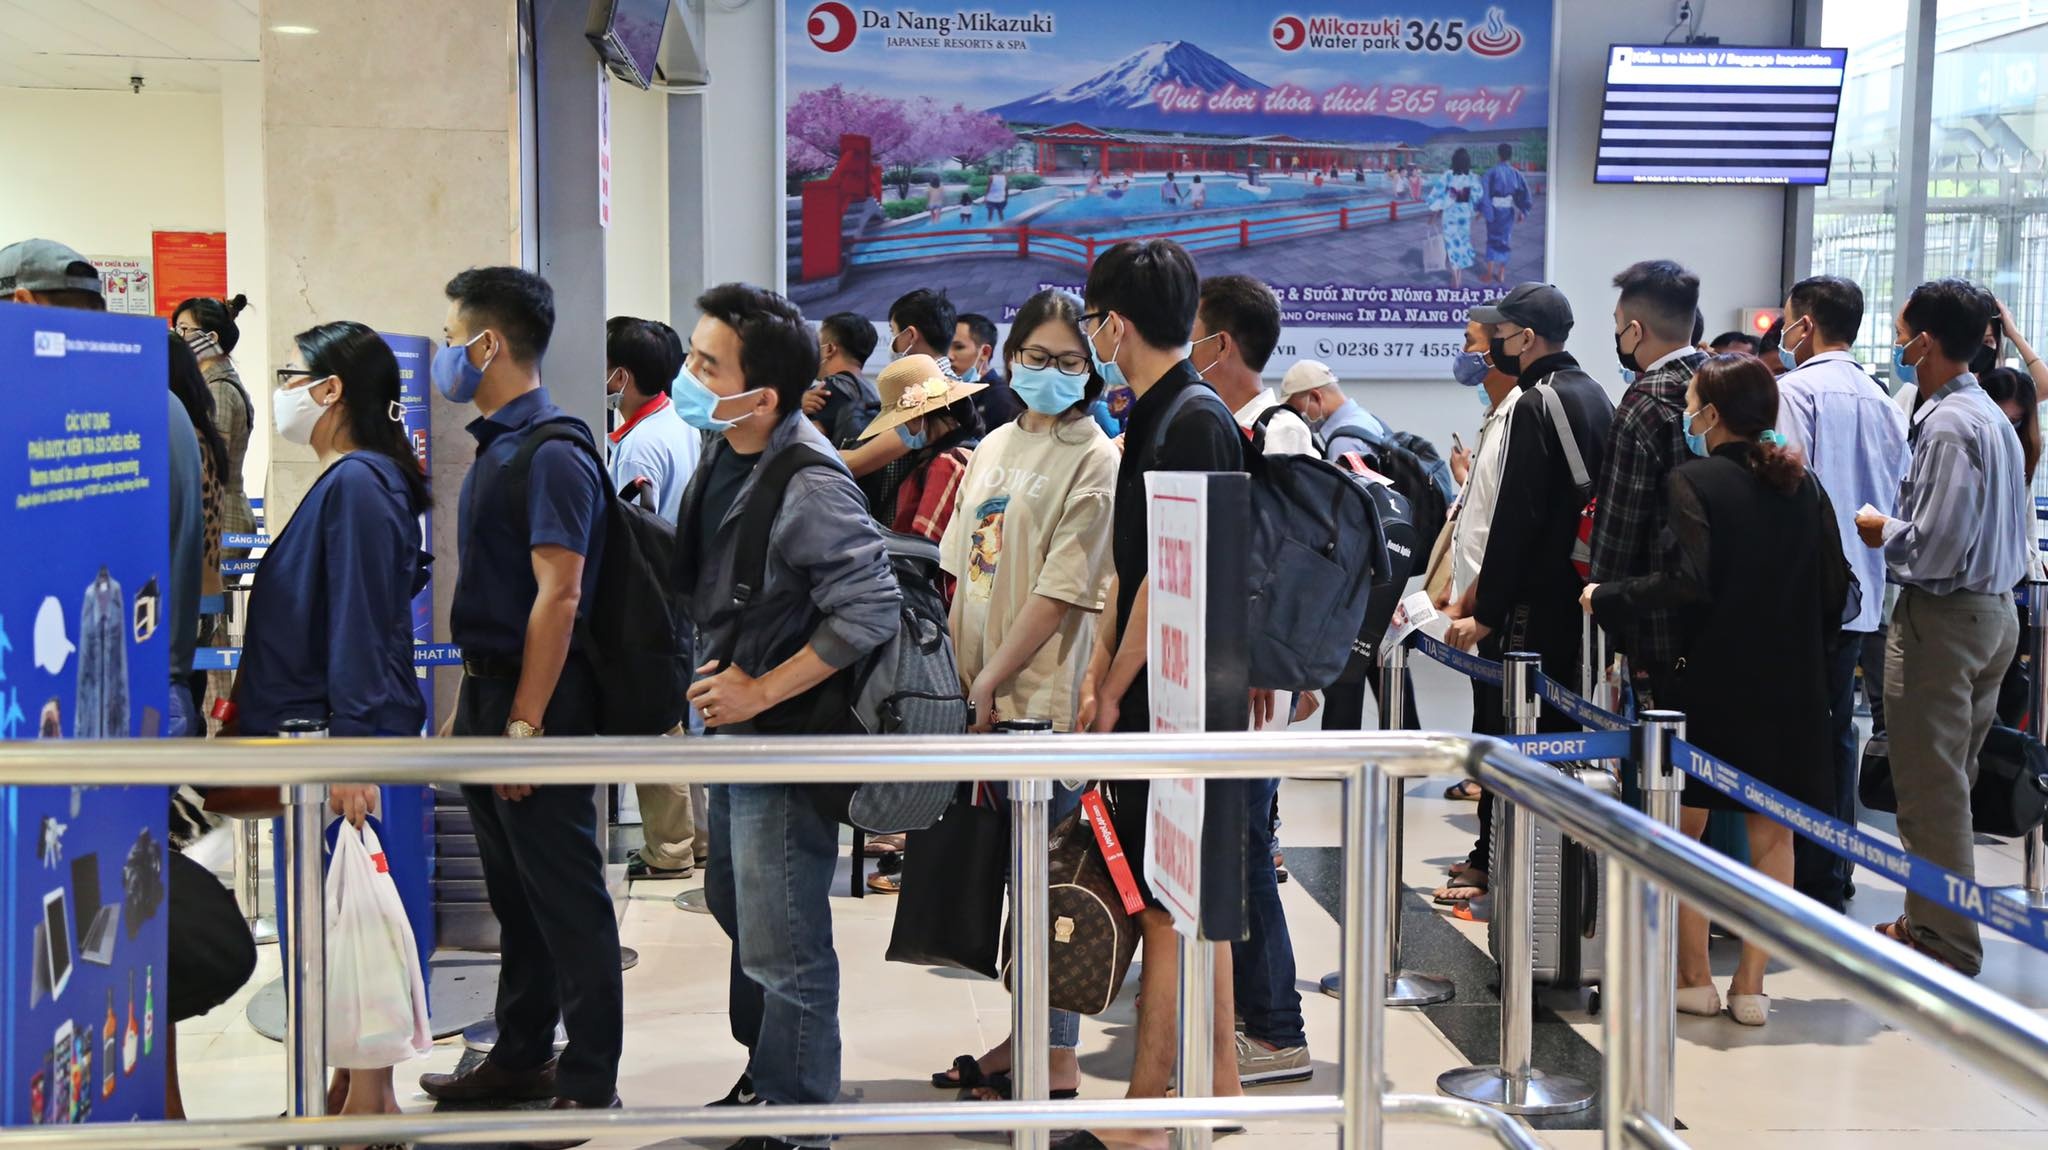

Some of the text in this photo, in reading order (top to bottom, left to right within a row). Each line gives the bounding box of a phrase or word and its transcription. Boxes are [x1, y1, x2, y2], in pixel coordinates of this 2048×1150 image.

[862, 10, 890, 29] Da
[1308, 18, 1400, 36] Mikazuki
[886, 36, 1028, 50] JAPANESE RESORTS & SPA
[1309, 35, 1401, 52] Water park
[1404, 20, 1464, 52] 365
[1156, 84, 1200, 111] Vui
[1207, 85, 1257, 112] chơi
[1321, 85, 1378, 112] thích
[1385, 88, 1438, 113] 365
[1444, 88, 1502, 122] ngày
[1287, 286, 1300, 301] &
[1279, 311, 1303, 321] AND
[1336, 341, 1379, 357] 0236
[1383, 342, 1415, 357] 377
[233, 562, 259, 571] AIRP
[1689, 750, 1714, 783] TIA
[1943, 873, 1985, 917] TIA
